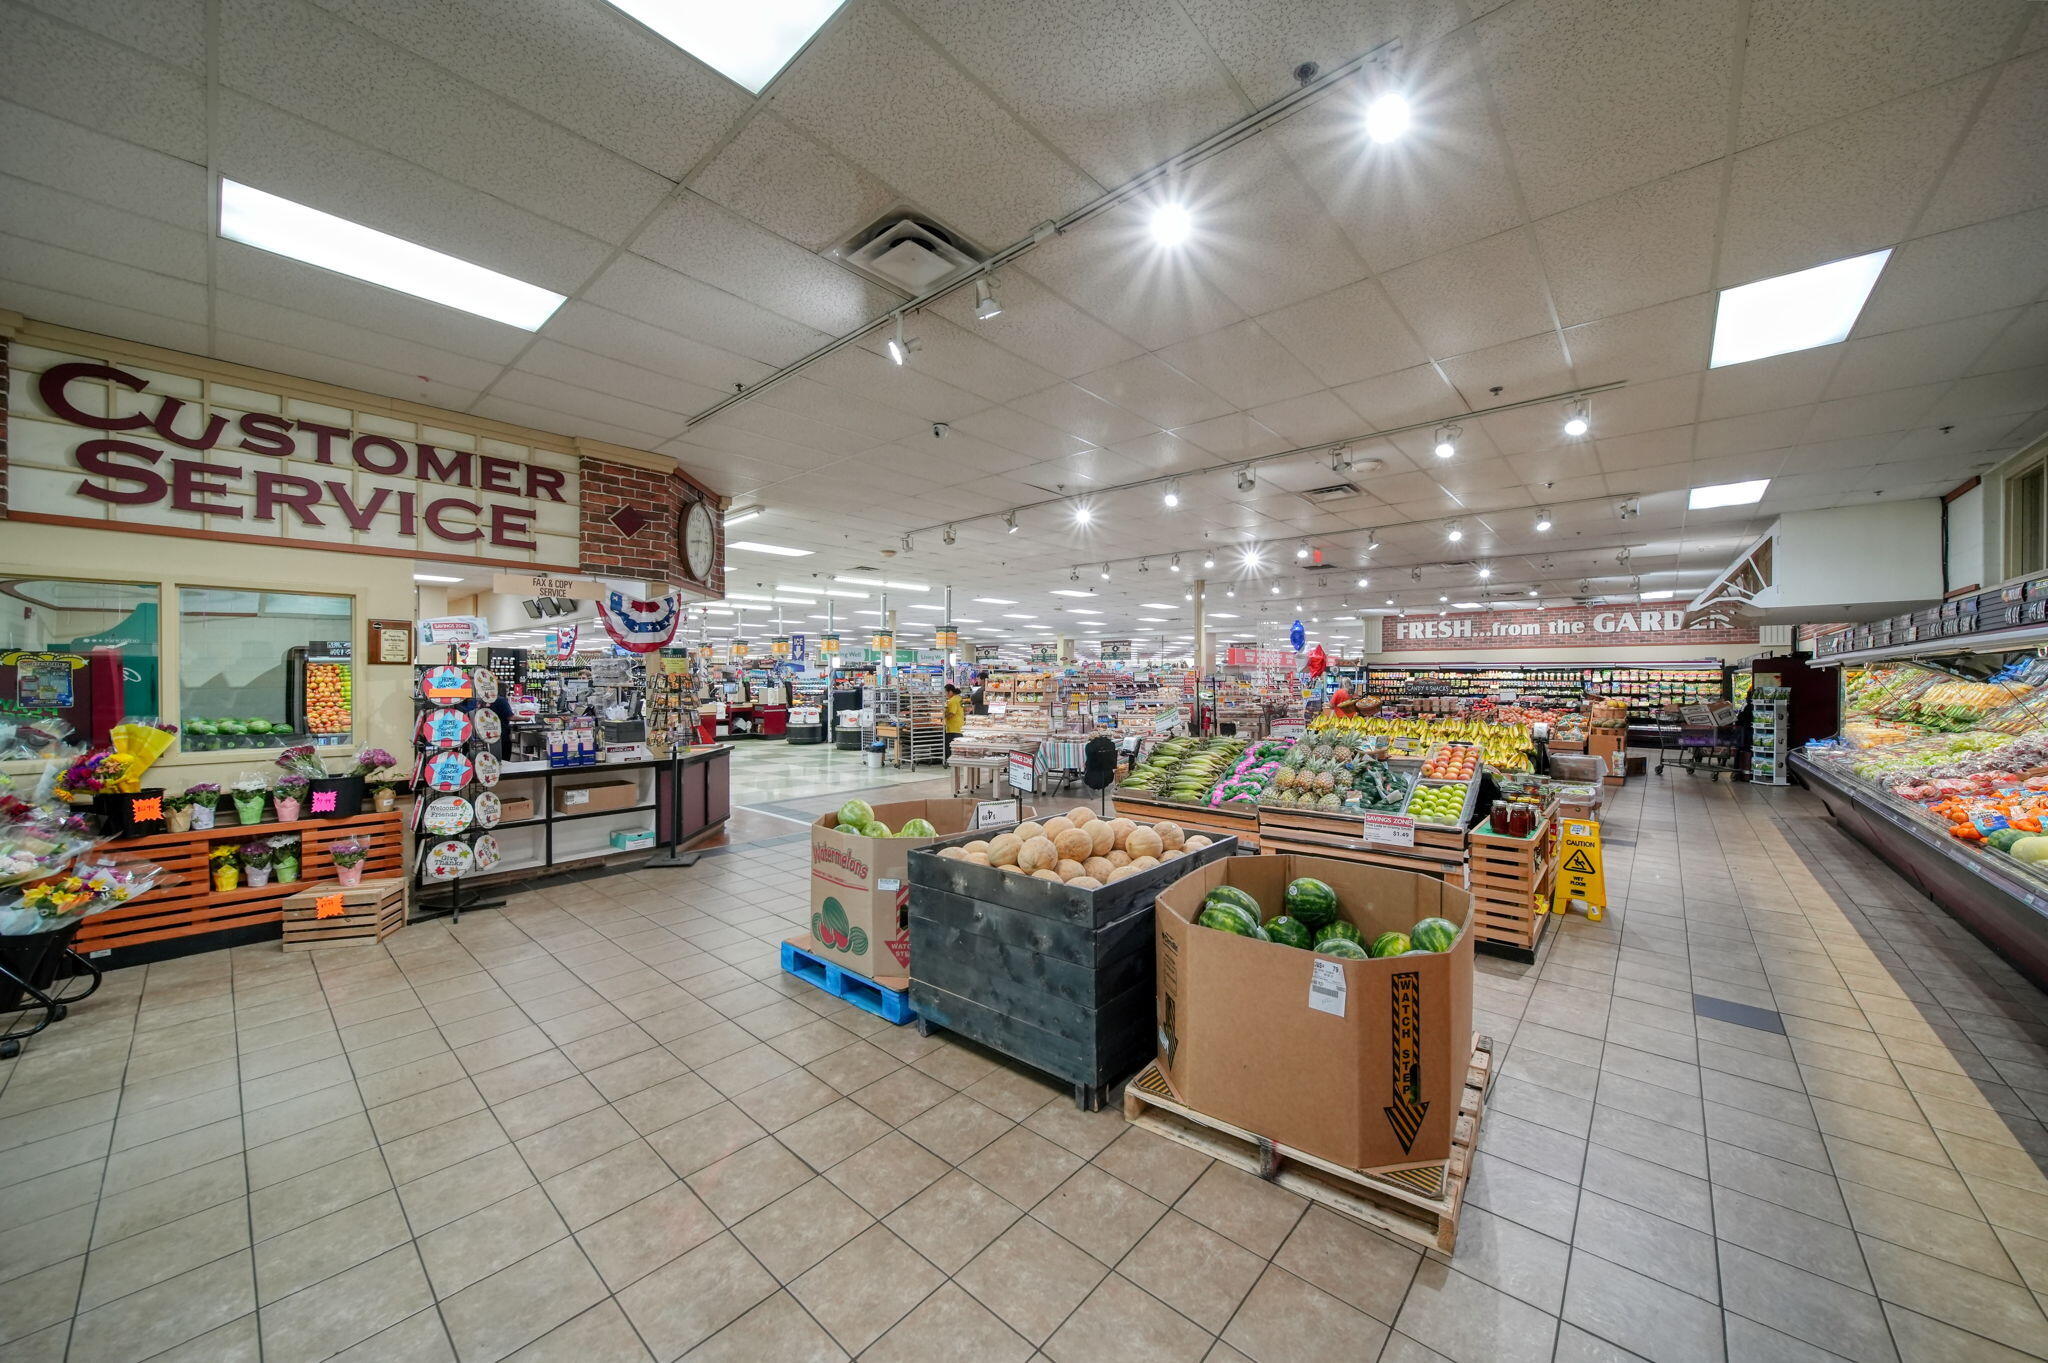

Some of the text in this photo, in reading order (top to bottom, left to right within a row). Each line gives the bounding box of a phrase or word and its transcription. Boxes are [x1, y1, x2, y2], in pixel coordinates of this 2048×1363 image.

[532, 578, 573, 589] FAX & COPY
[539, 587, 567, 598] SERVICE
[1547, 619, 1585, 635] the
[793, 638, 804, 646] ICE
[1366, 815, 1391, 823] SAVINGS
[1392, 830, 1410, 838] $1.49
[1566, 839, 1596, 848] CAUTION
[434, 859, 463, 867] Thanks
[812, 840, 869, 880] Watermelons
[1400, 980, 1411, 1039] WATCH
[1402, 1049, 1411, 1095] STEP
